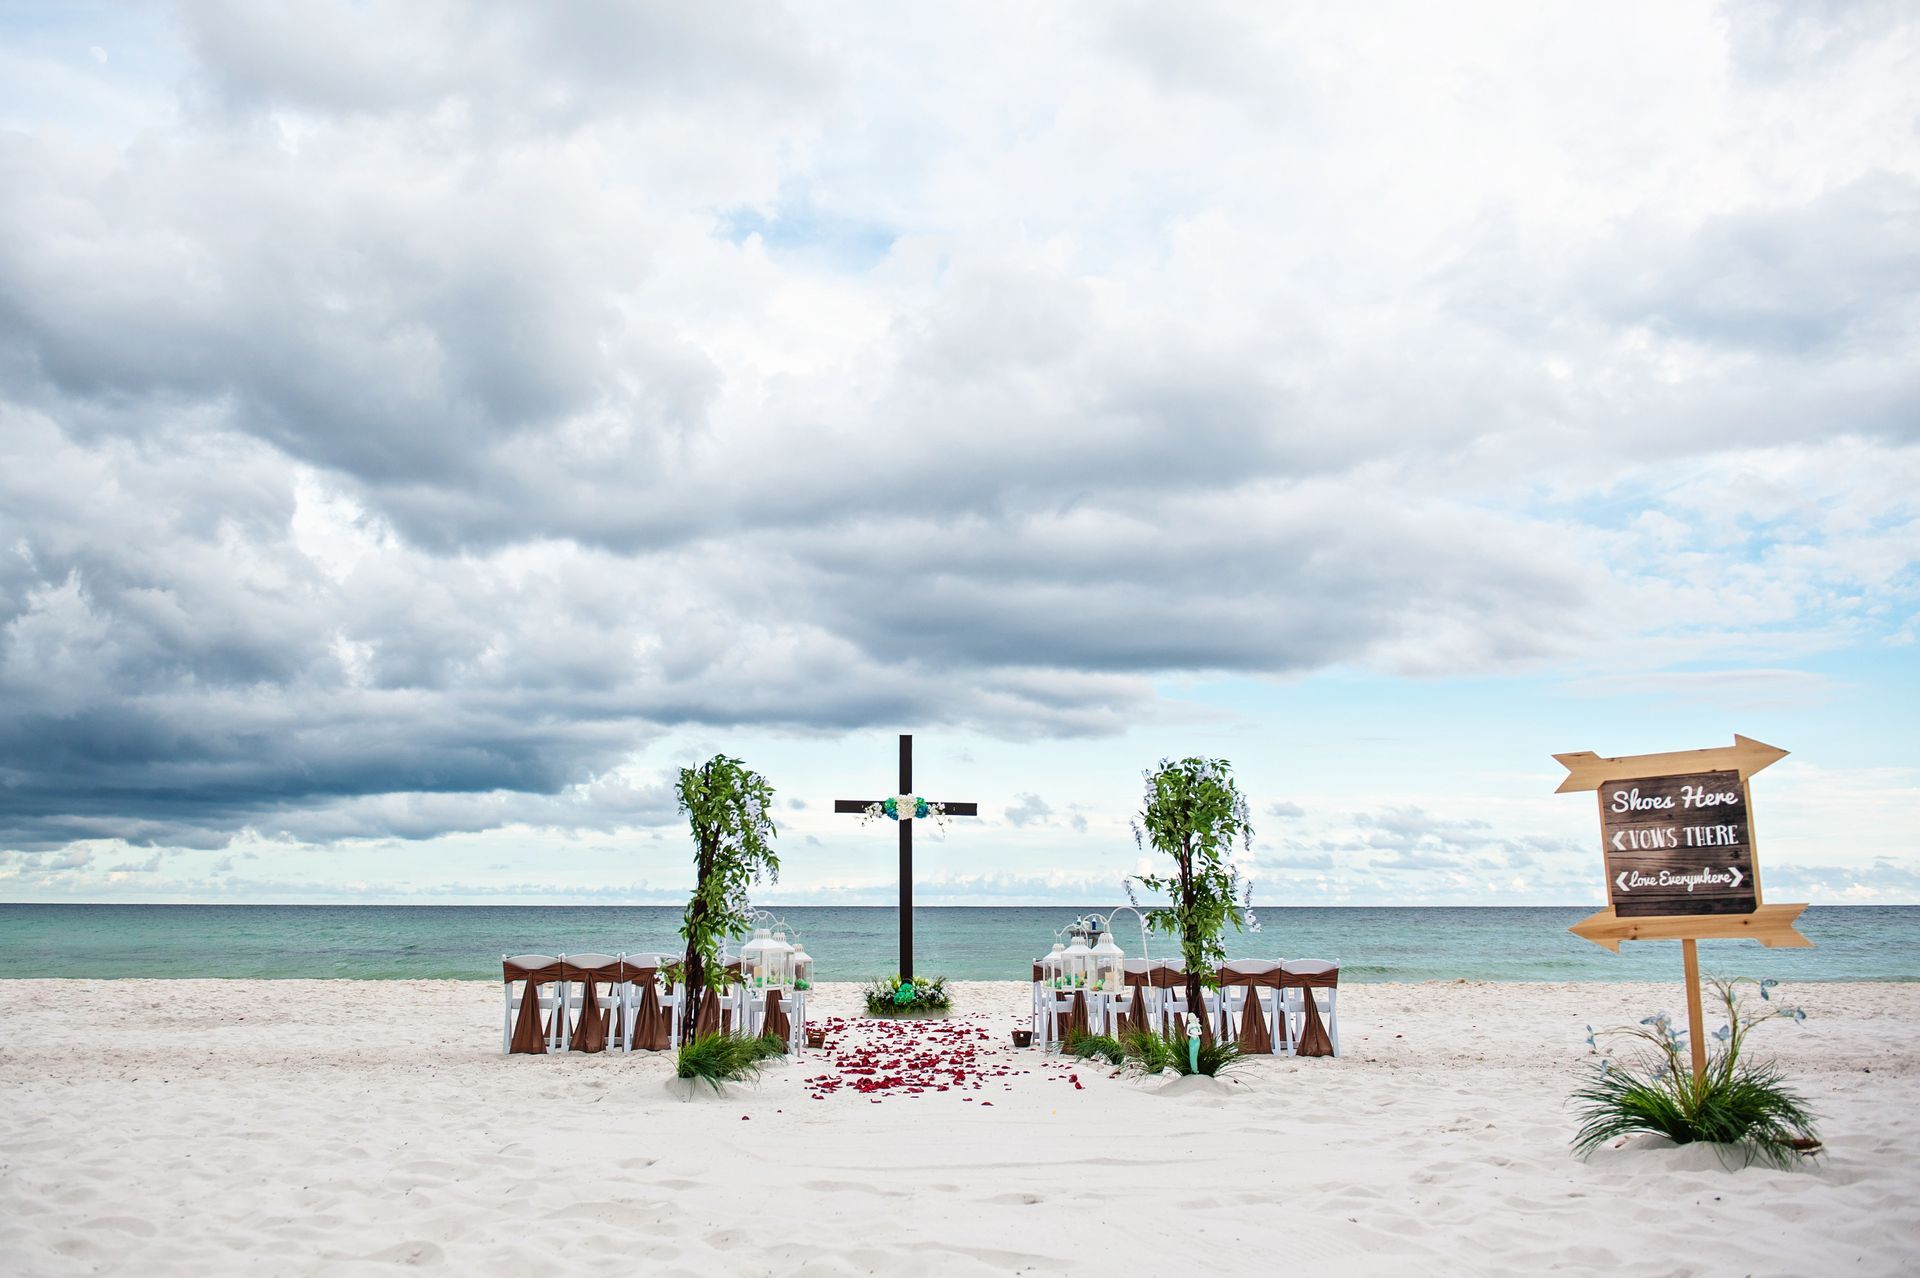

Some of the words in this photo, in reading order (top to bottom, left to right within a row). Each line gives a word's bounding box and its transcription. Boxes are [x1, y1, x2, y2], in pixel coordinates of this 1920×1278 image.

[1611, 788, 1675, 813] Shoes
[1680, 785, 1739, 808] Here
[1628, 827, 1678, 849] VOWS
[1683, 824, 1739, 847] THERE
[1659, 867, 1732, 892] Everywhere
